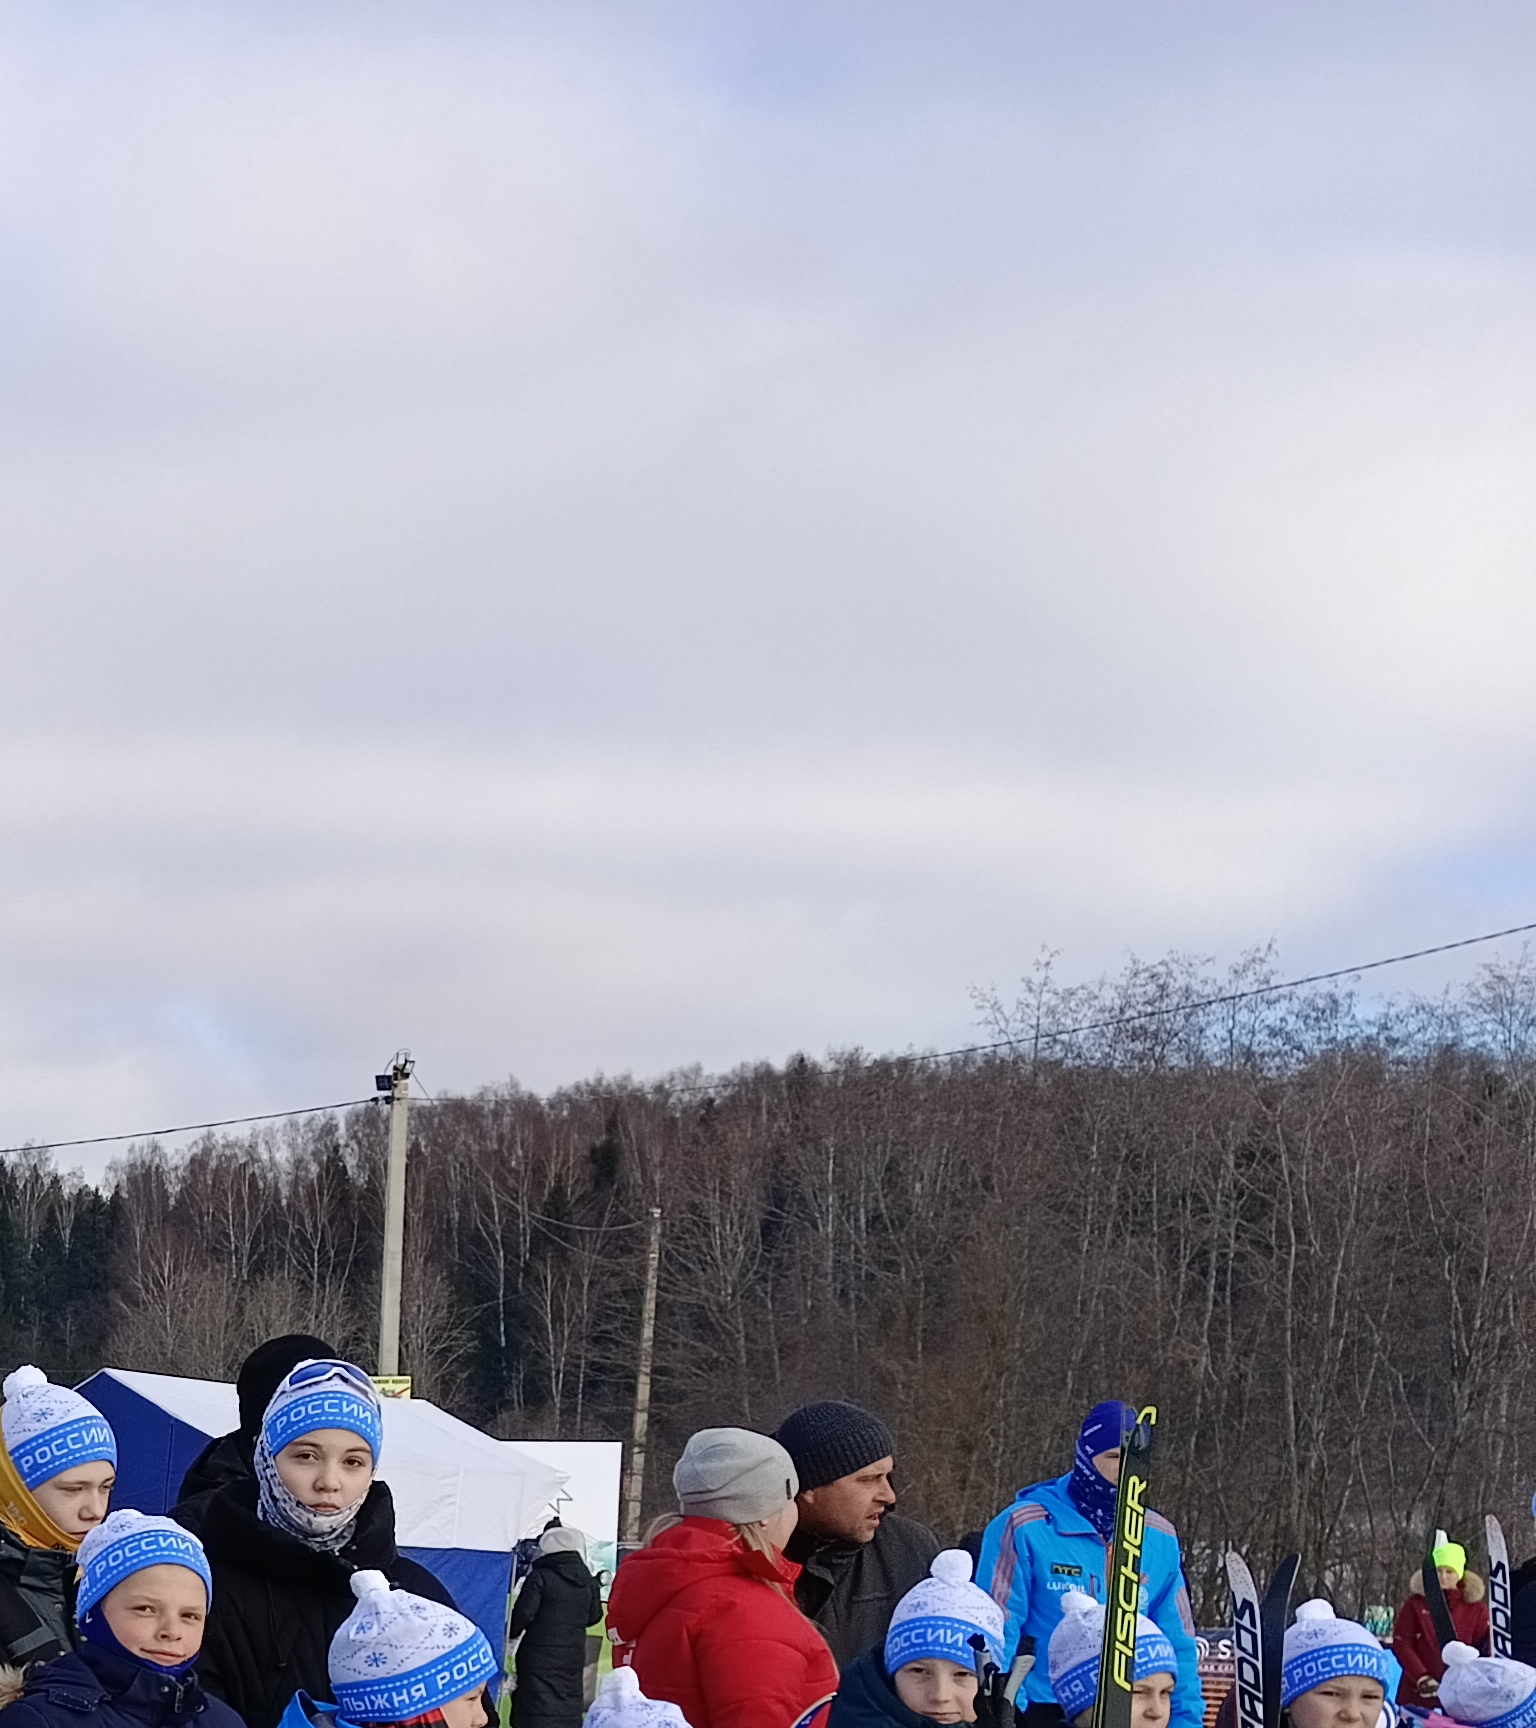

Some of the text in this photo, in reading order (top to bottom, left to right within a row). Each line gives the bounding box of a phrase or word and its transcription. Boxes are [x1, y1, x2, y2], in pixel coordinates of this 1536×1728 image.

[275, 1399, 371, 1434] РОССИИ
[19, 1426, 111, 1474] РОССИИ
[94, 1533, 195, 1579] РОССИИ
[1113, 1475, 1147, 1691] FISCHER
[1489, 1555, 1512, 1659] ADOS
[435, 1646, 491, 1692] РОСС
[1294, 1653, 1378, 1684] РОССИИ
